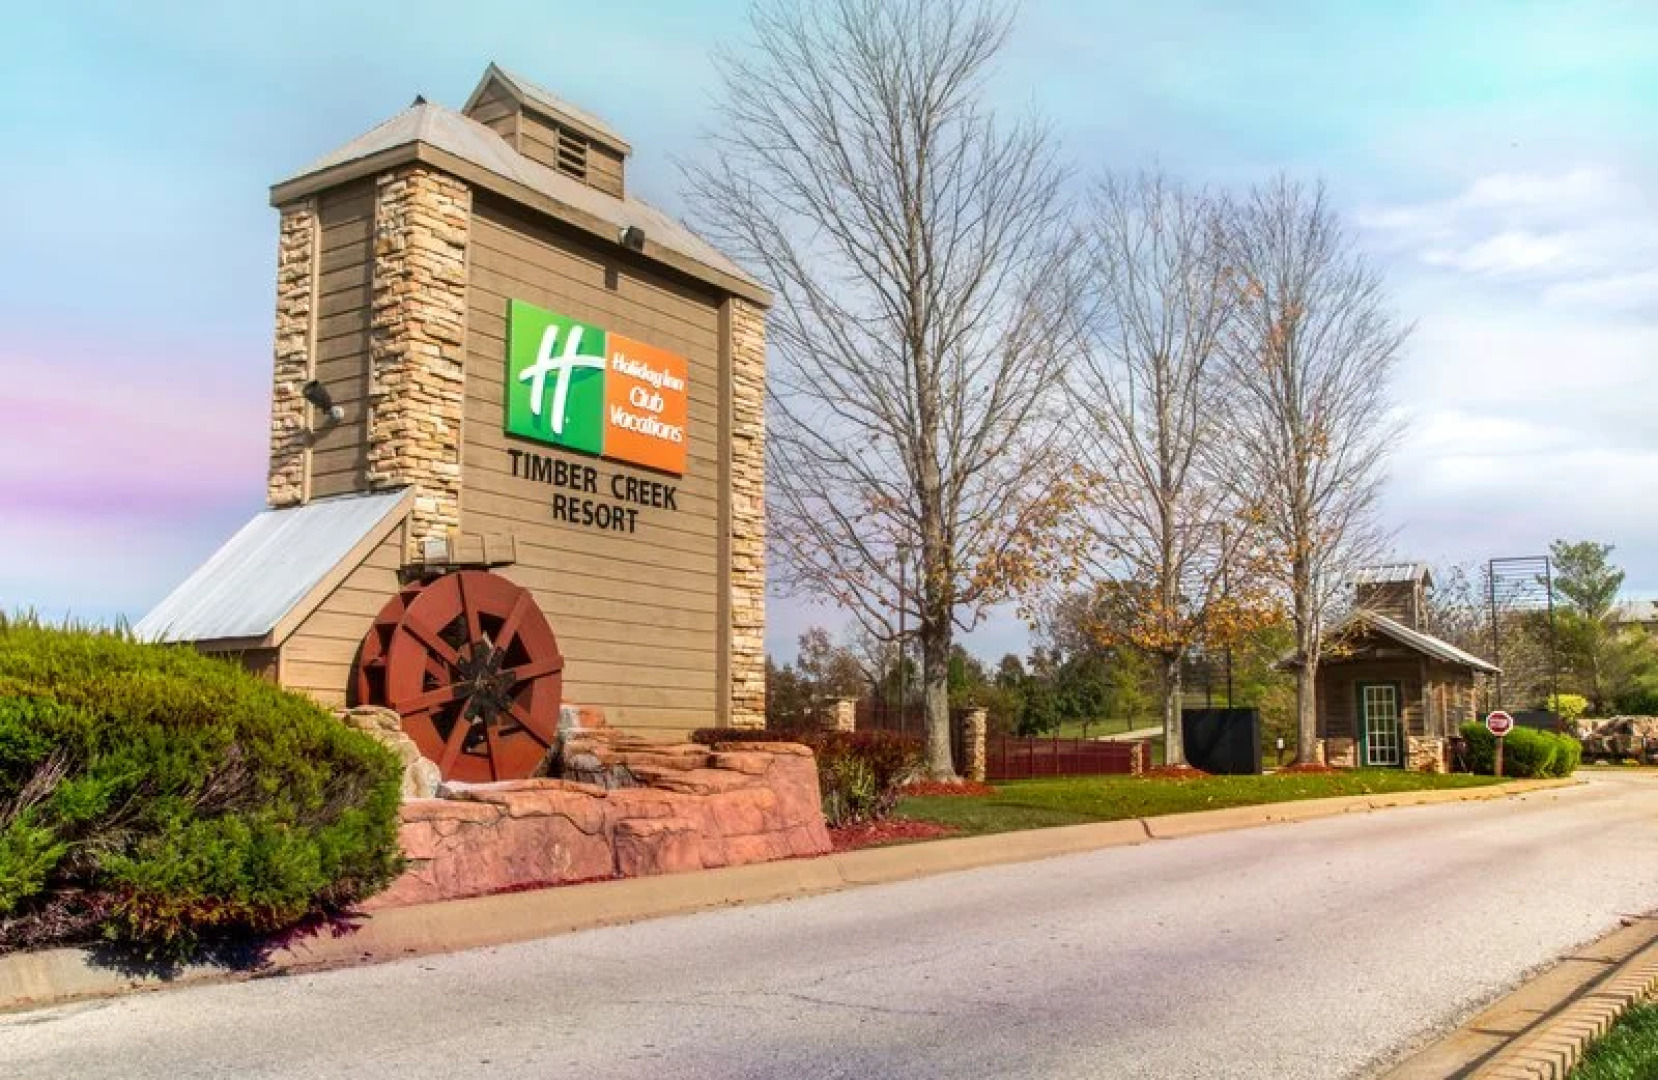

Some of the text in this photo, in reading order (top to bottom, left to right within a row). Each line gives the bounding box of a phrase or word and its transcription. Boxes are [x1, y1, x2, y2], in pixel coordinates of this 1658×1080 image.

[612, 352, 684, 391] Holiday Inn
[629, 386, 664, 414] Club
[610, 403, 682, 443] Vacations
[508, 448, 678, 511] TIMBER CREEK
[552, 493, 639, 534] RESORT
